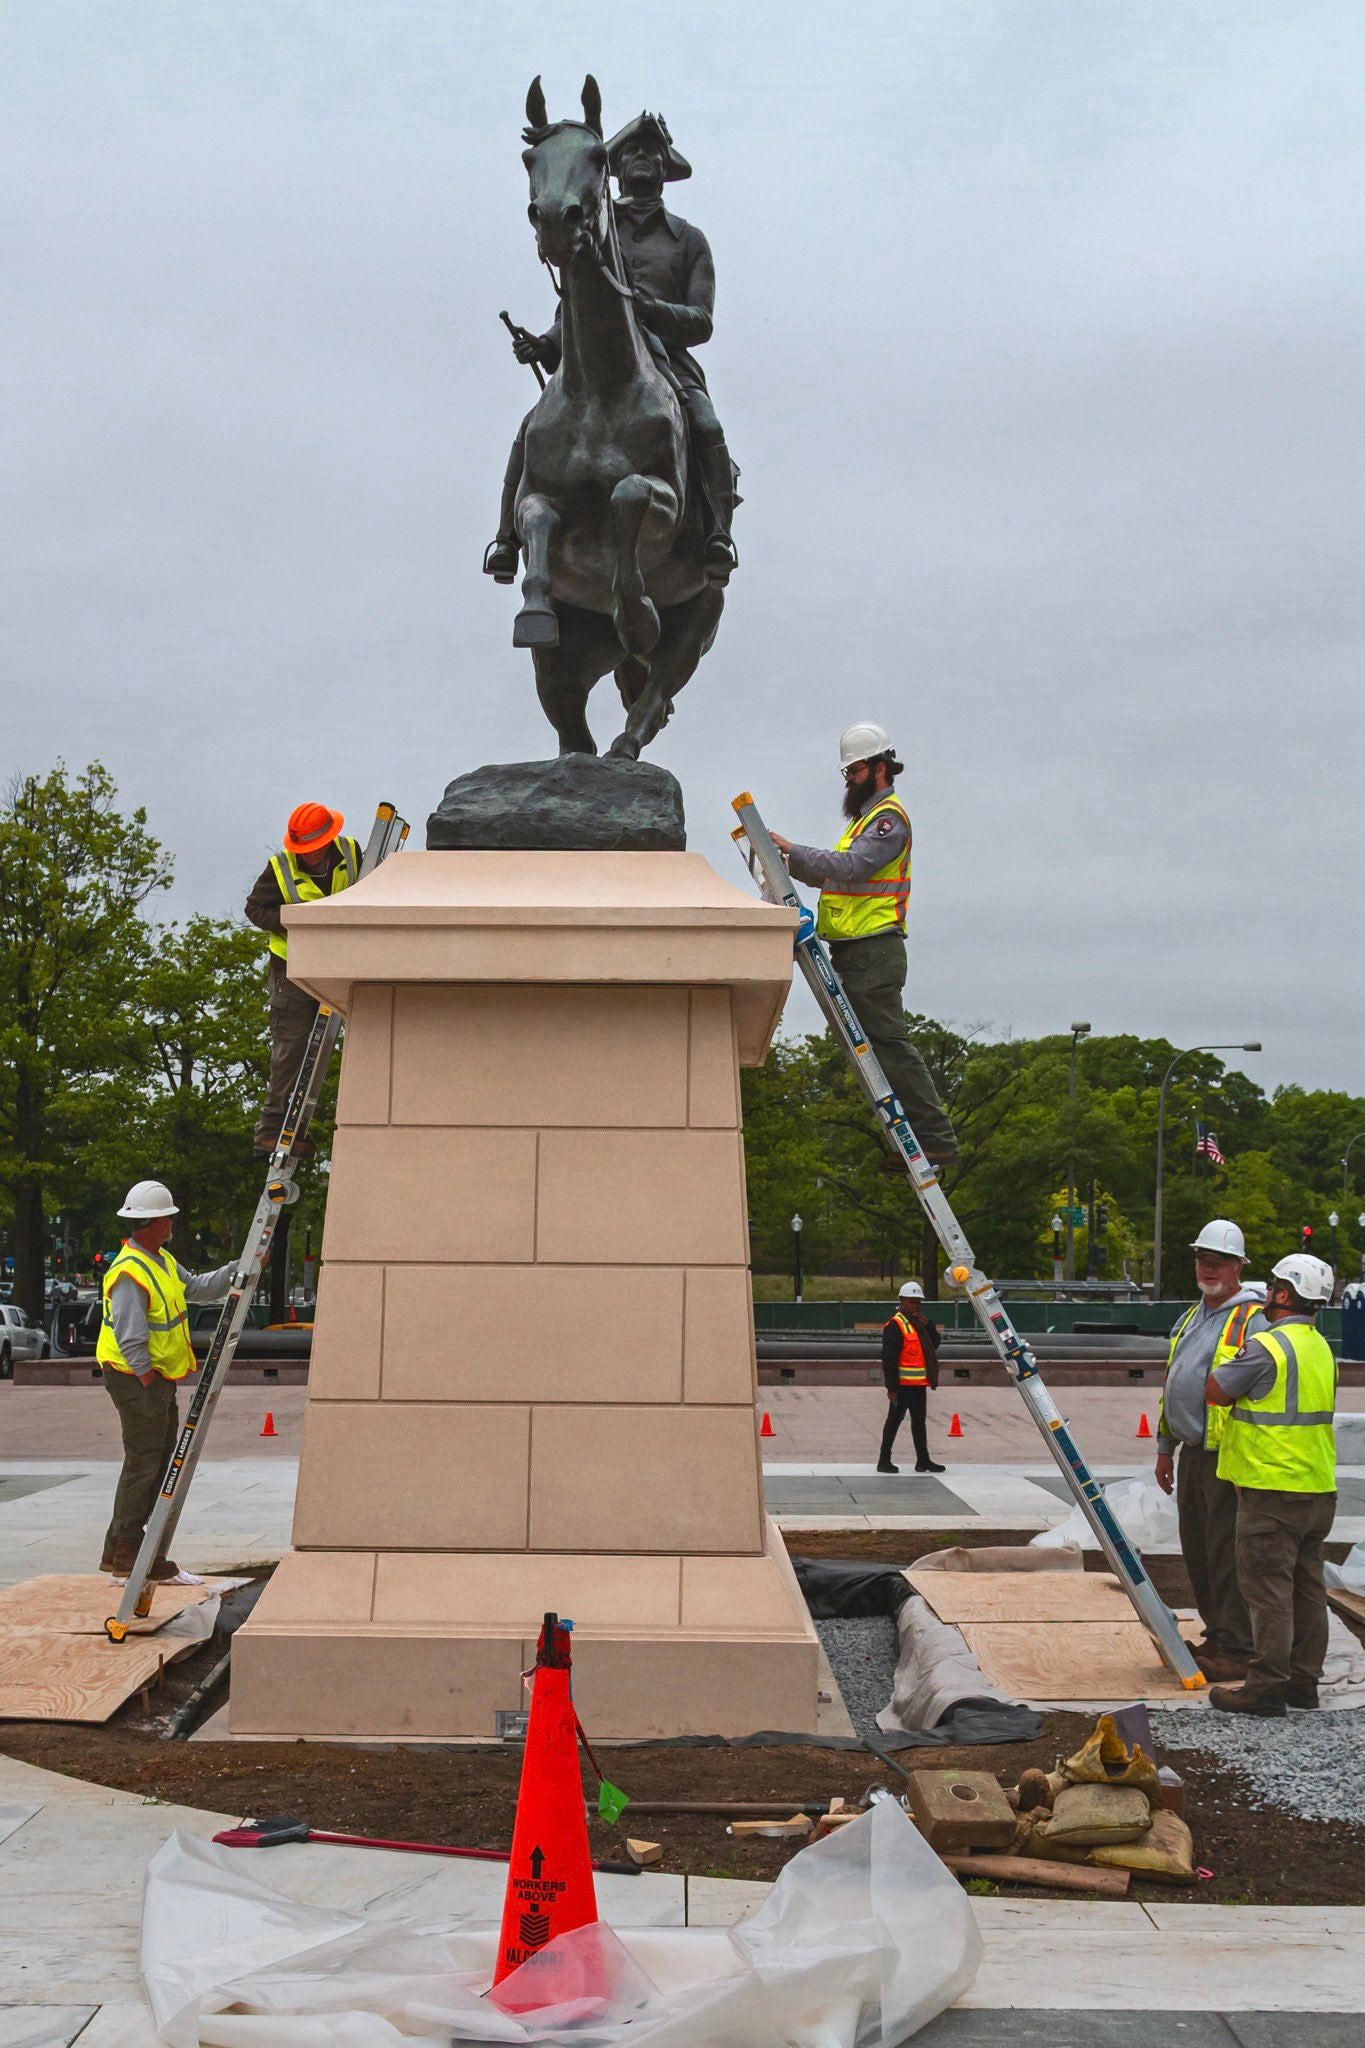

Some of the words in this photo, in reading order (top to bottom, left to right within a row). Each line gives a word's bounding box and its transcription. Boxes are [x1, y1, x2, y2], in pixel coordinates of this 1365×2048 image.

[816, 957, 832, 984] WERNER
[852, 1028, 863, 1042] PRO
[165, 1467, 178, 1494] GORILLA
[178, 1429, 192, 1458] LADDERS
[513, 1879, 567, 1892] WORKERS
[518, 1890, 556, 1902] ABOVE
